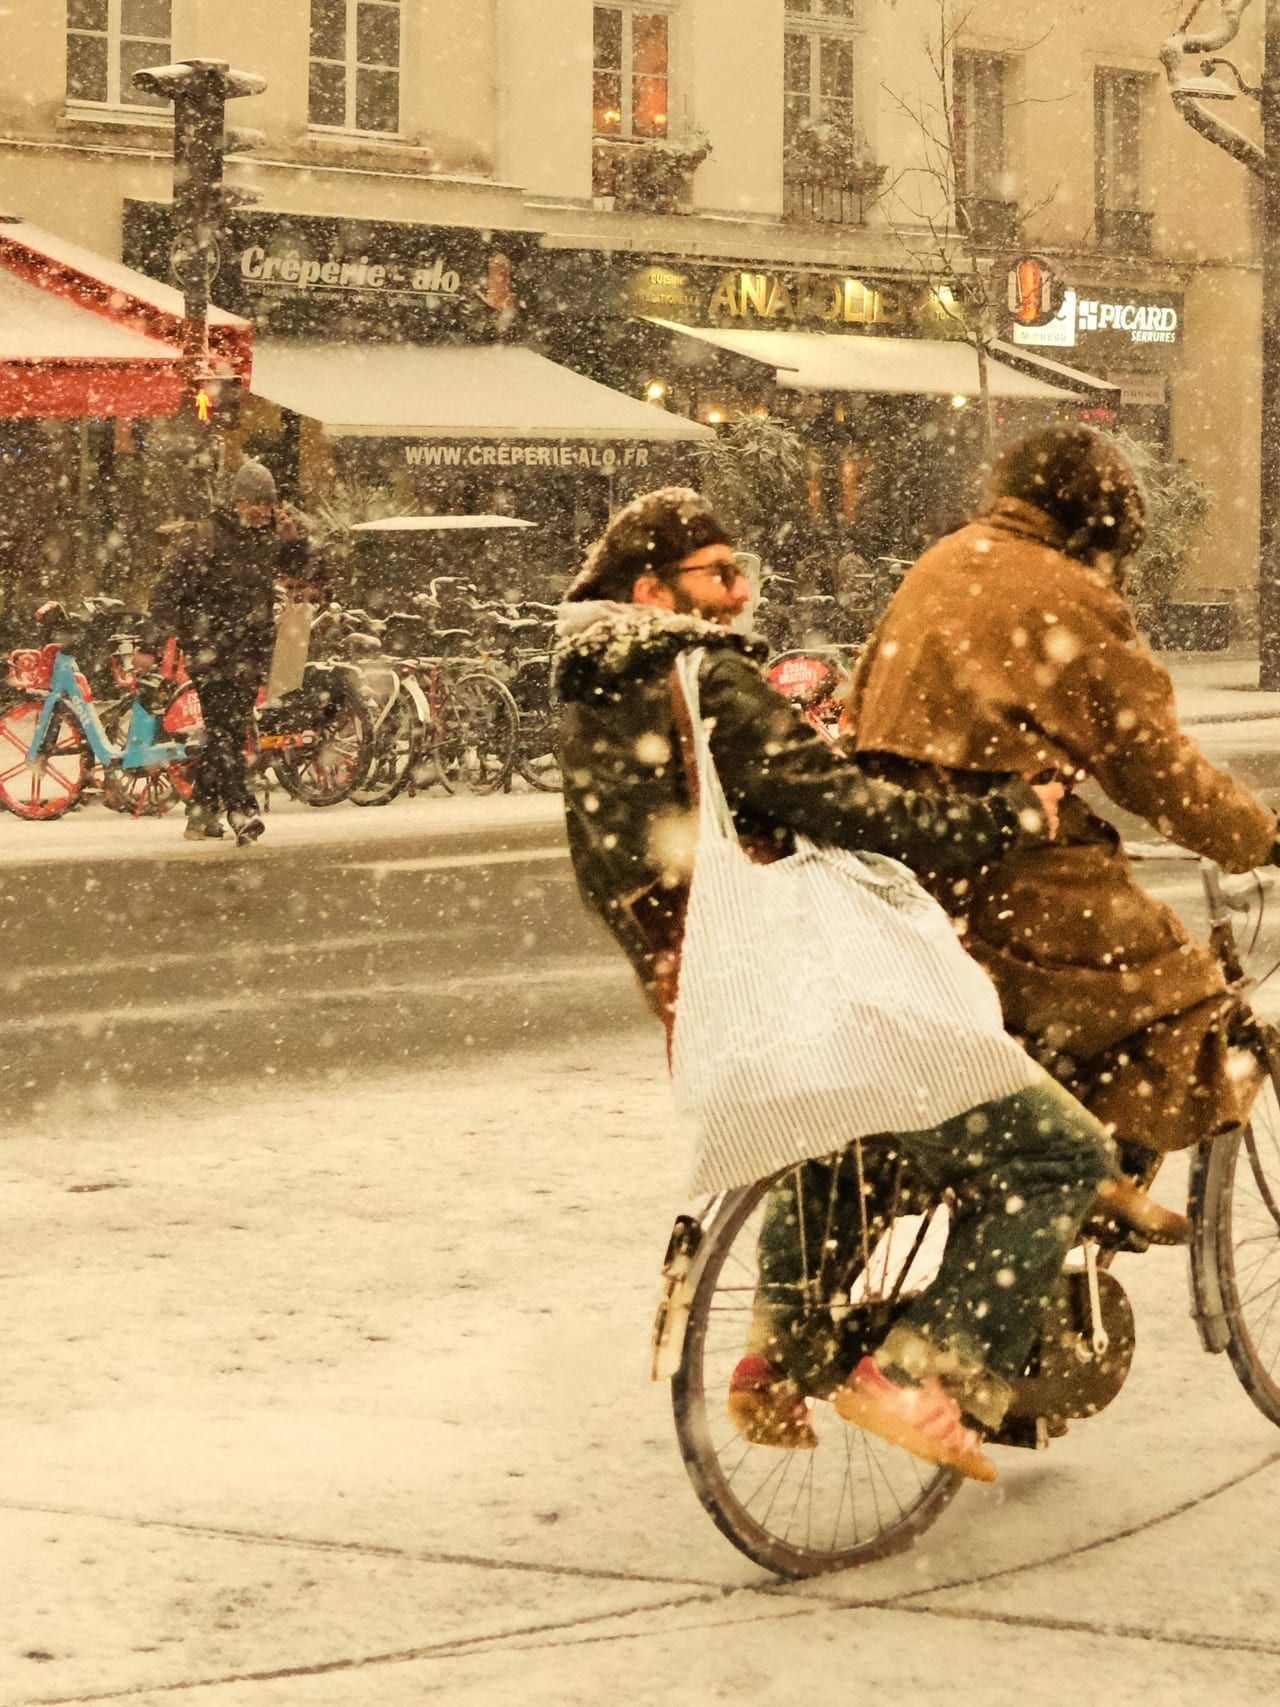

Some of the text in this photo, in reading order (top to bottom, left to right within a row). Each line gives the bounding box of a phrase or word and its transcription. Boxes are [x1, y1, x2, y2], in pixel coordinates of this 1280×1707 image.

[241, 245, 386, 288] Crêperie
[411, 259, 460, 292] alo
[1099, 304, 1177, 331] PICARD
[1131, 331, 1176, 343] SERRURES
